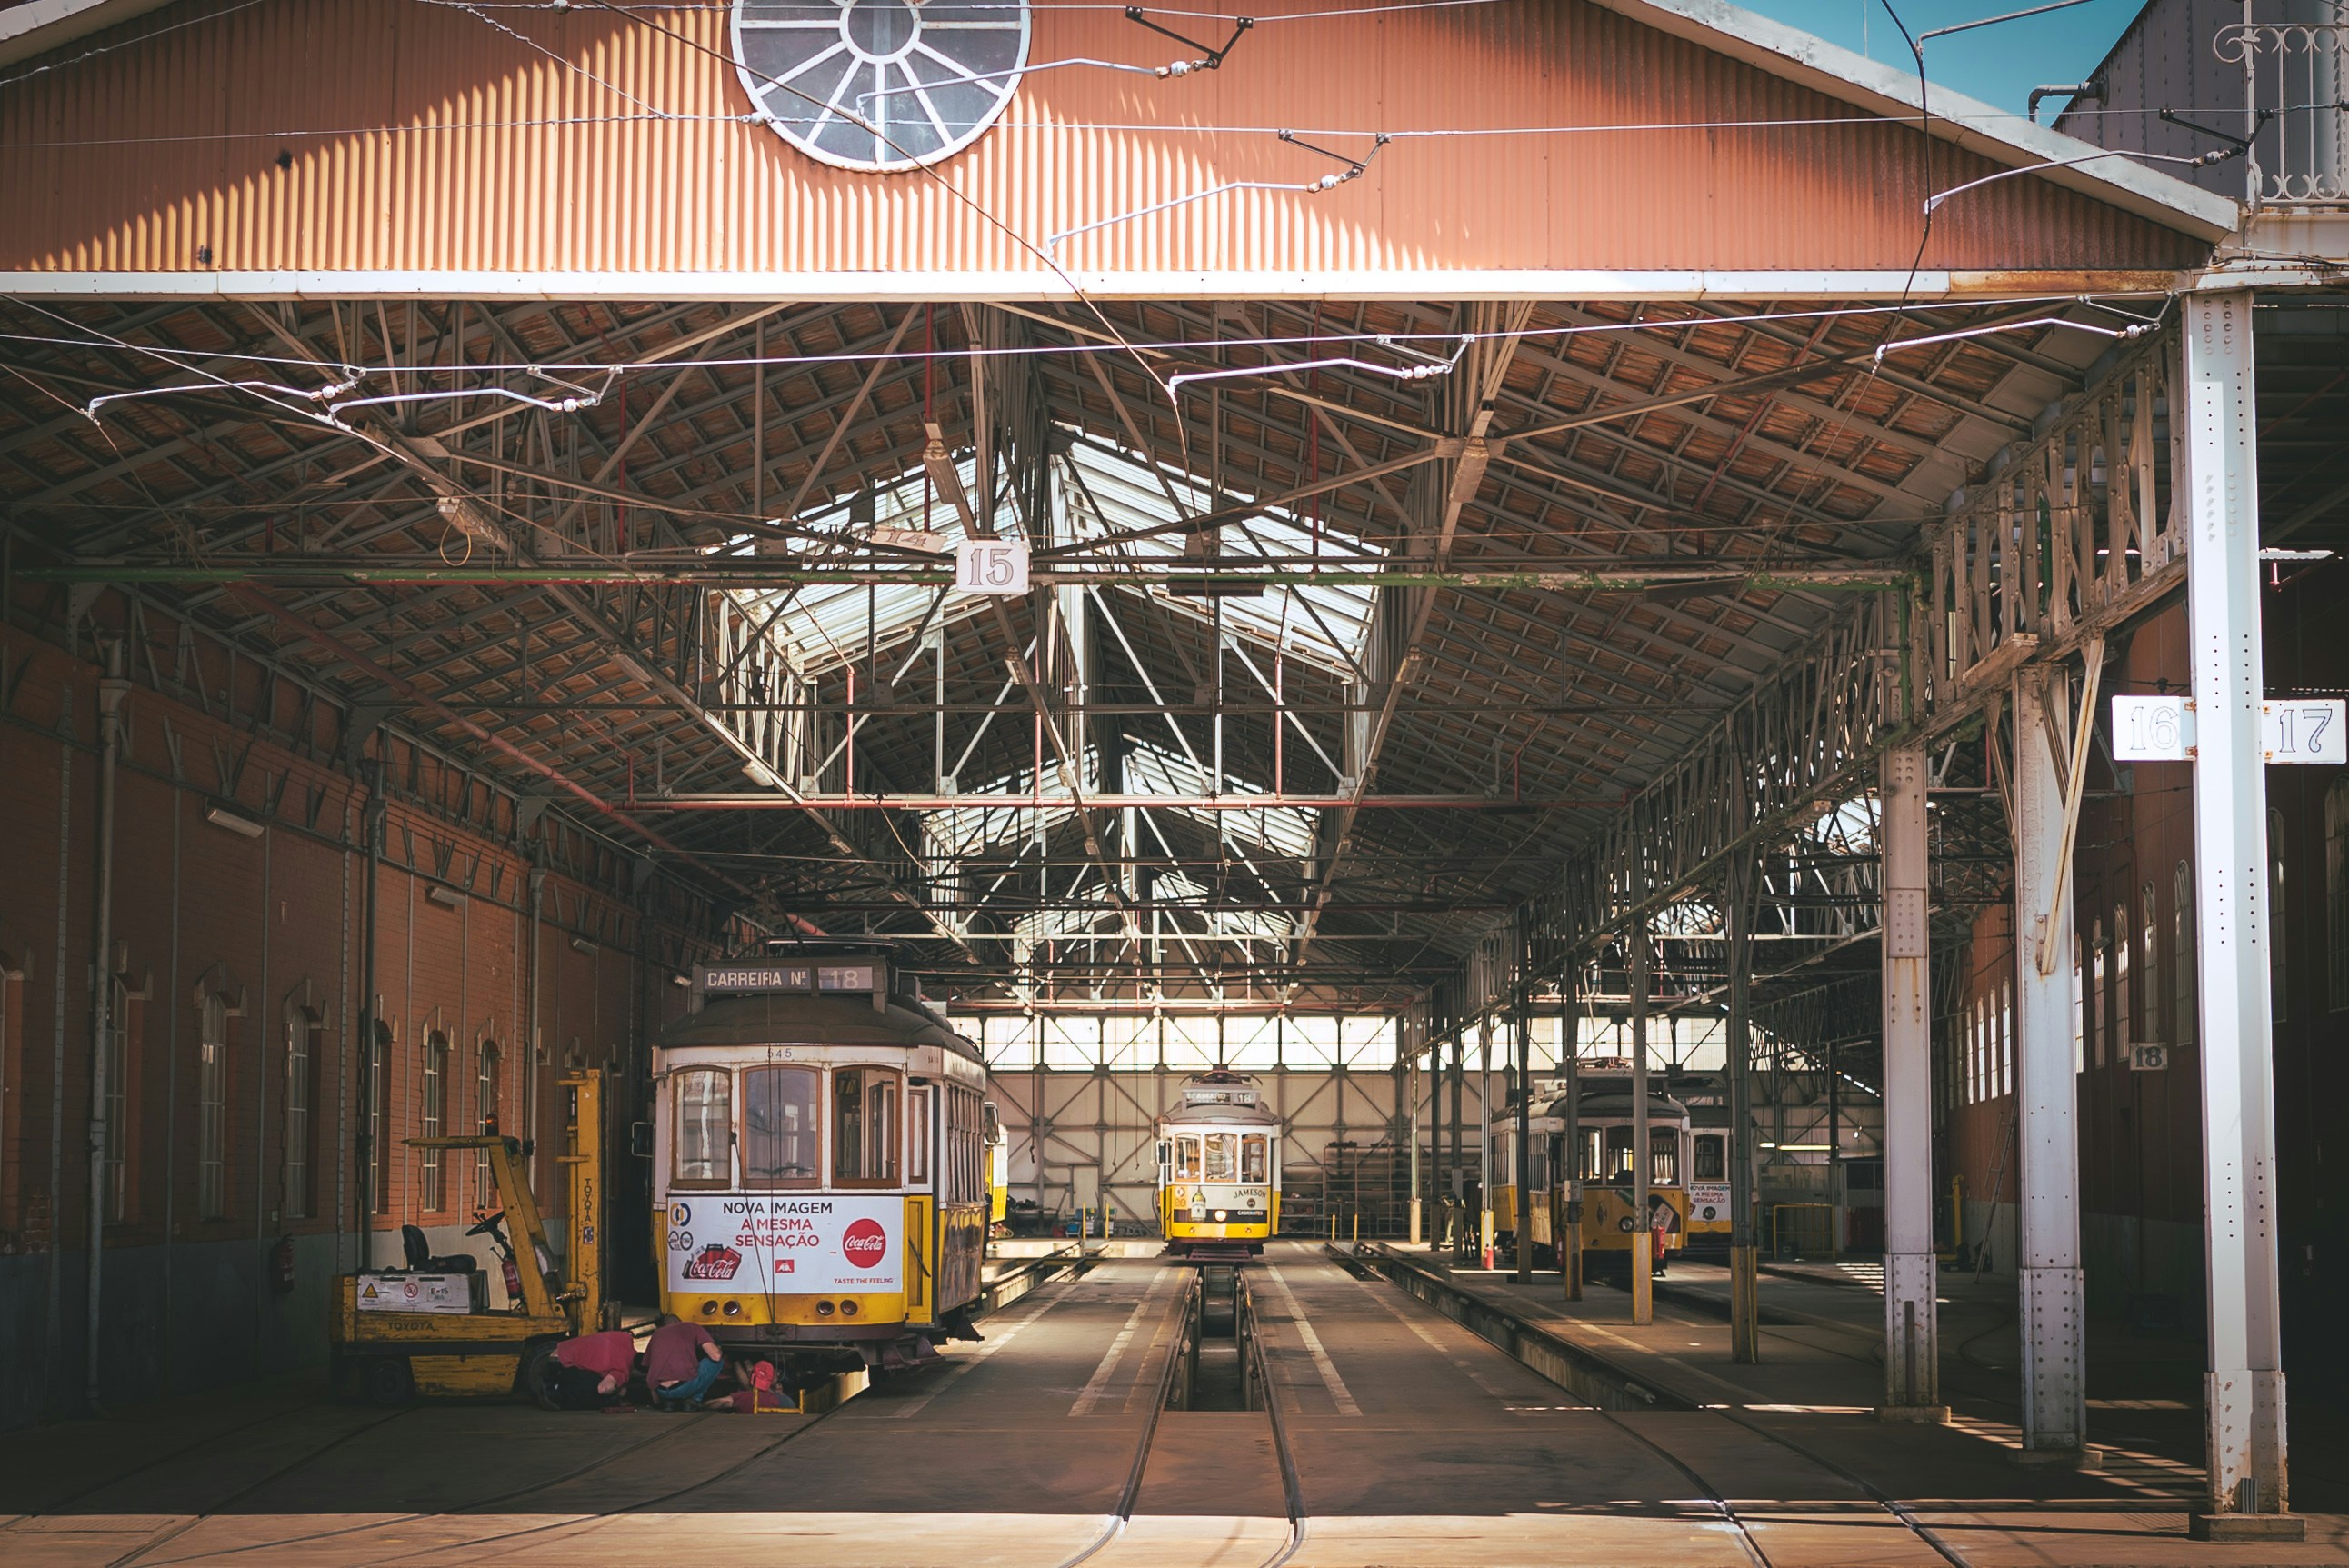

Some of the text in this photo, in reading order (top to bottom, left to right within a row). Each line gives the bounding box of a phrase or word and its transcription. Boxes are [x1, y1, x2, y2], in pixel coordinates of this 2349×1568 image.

[968, 548, 1015, 586] 15
[2131, 705, 2179, 751] 16
[2279, 708, 2333, 754] 17
[707, 971, 783, 987] CARREIRA
[829, 969, 859, 989] 18
[767, 1047, 792, 1059] 545
[2135, 1046, 2163, 1067] 18
[1238, 1094, 1252, 1104] 18
[584, 1178, 592, 1222] TOYOTA
[1233, 1188, 1266, 1199] JAMESON
[723, 1202, 832, 1214] NOVA IMAGEM
[741, 1218, 813, 1231] A MESMA
[735, 1232, 820, 1249] SENSAÇÃO
[387, 1322, 435, 1332] TOYOTA
